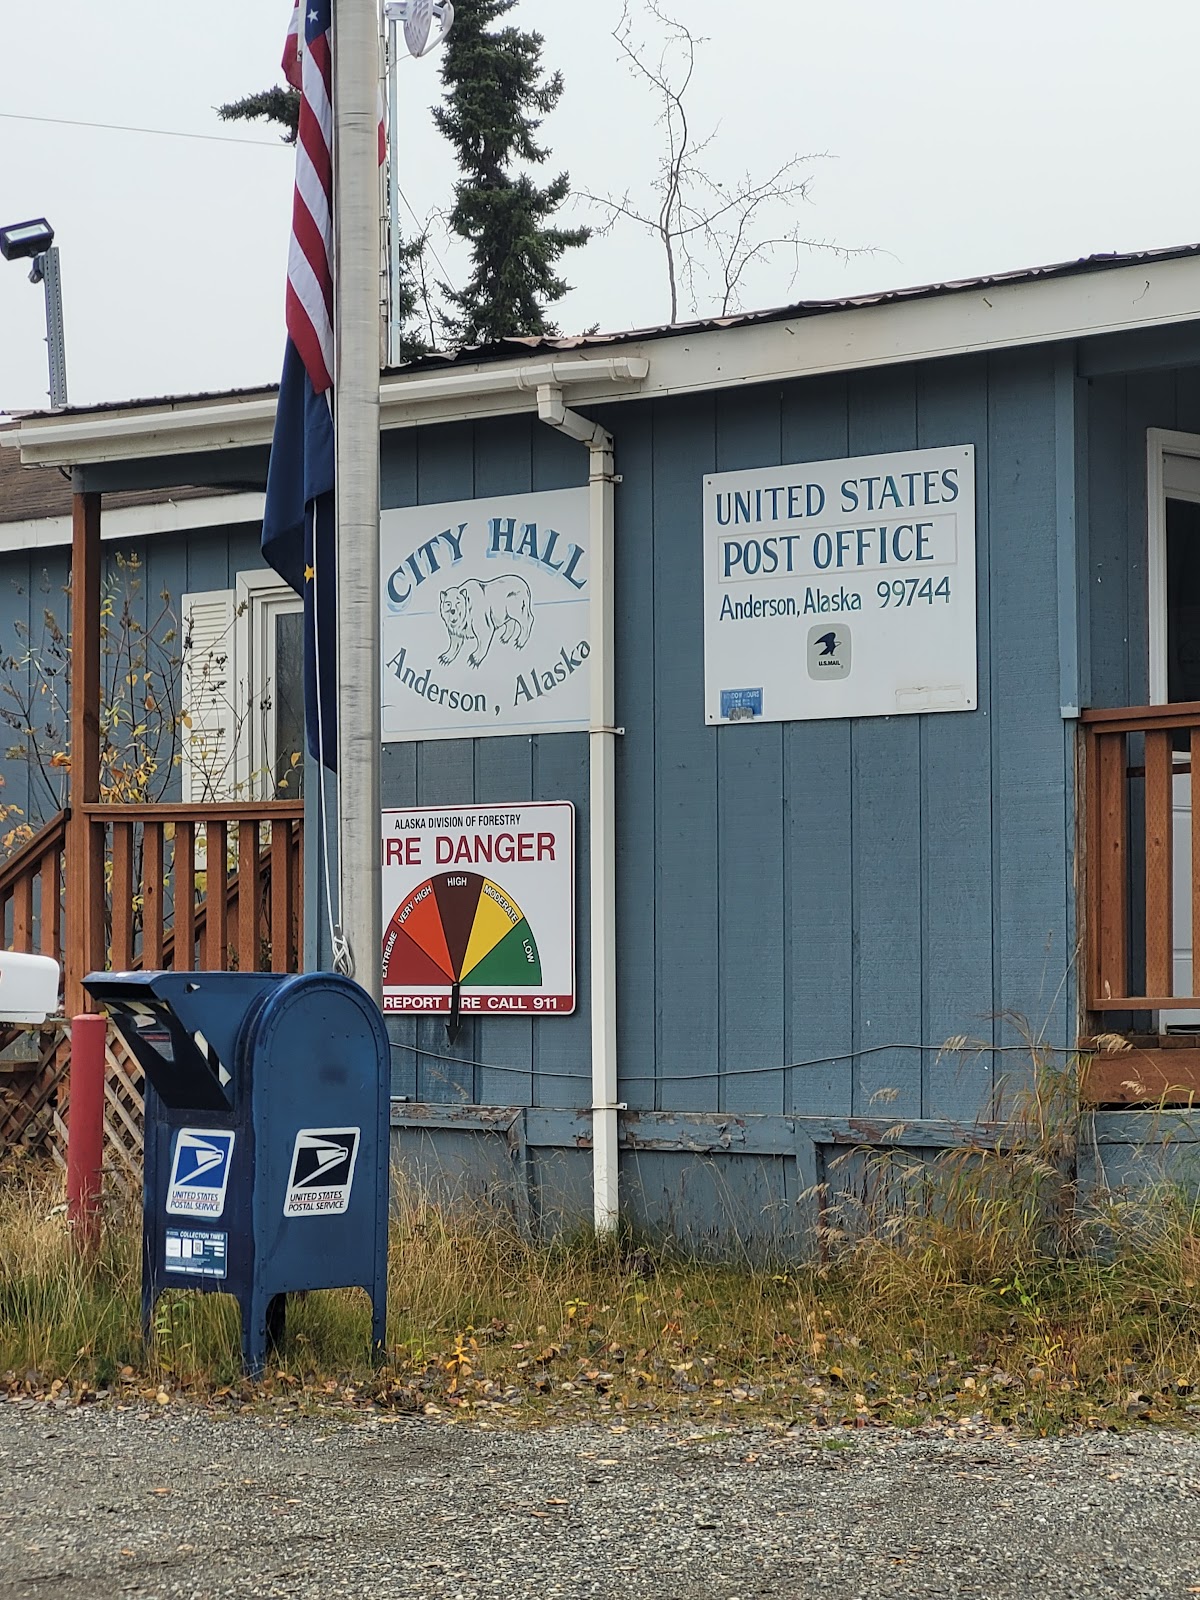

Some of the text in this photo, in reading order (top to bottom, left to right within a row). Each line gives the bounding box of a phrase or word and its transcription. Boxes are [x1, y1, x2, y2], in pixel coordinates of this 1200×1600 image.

[716, 468, 959, 525] UNITED STATES
[387, 517, 588, 604] CITY HALL
[723, 522, 934, 577] POST OFFICE
[719, 576, 951, 621] Anderson, Alaska 99744
[513, 640, 590, 706] Alaska
[394, 814, 521, 830] ALASKA DIVISION OF FORESTRY
[381, 832, 556, 866] RE DANGER
[447, 876, 467, 887] HIGH
[397, 885, 432, 924] VERY HIGH
[483, 884, 519, 924] MODERATE
[382, 930, 398, 978] EXTREME
[522, 939, 535, 963] LOW
[383, 996, 443, 1009] REPORT
[487, 996, 527, 1009] CALL
[533, 996, 557, 1009] 911
[170, 1200, 220, 1211] POSTAL SERVICE
[172, 1191, 219, 1201] UNITED STATES
[288, 1200, 345, 1212] POSTAL SERVICE
[290, 1190, 343, 1202] UNITED STATES
[180, 1230, 210, 1240] COLLECTION
